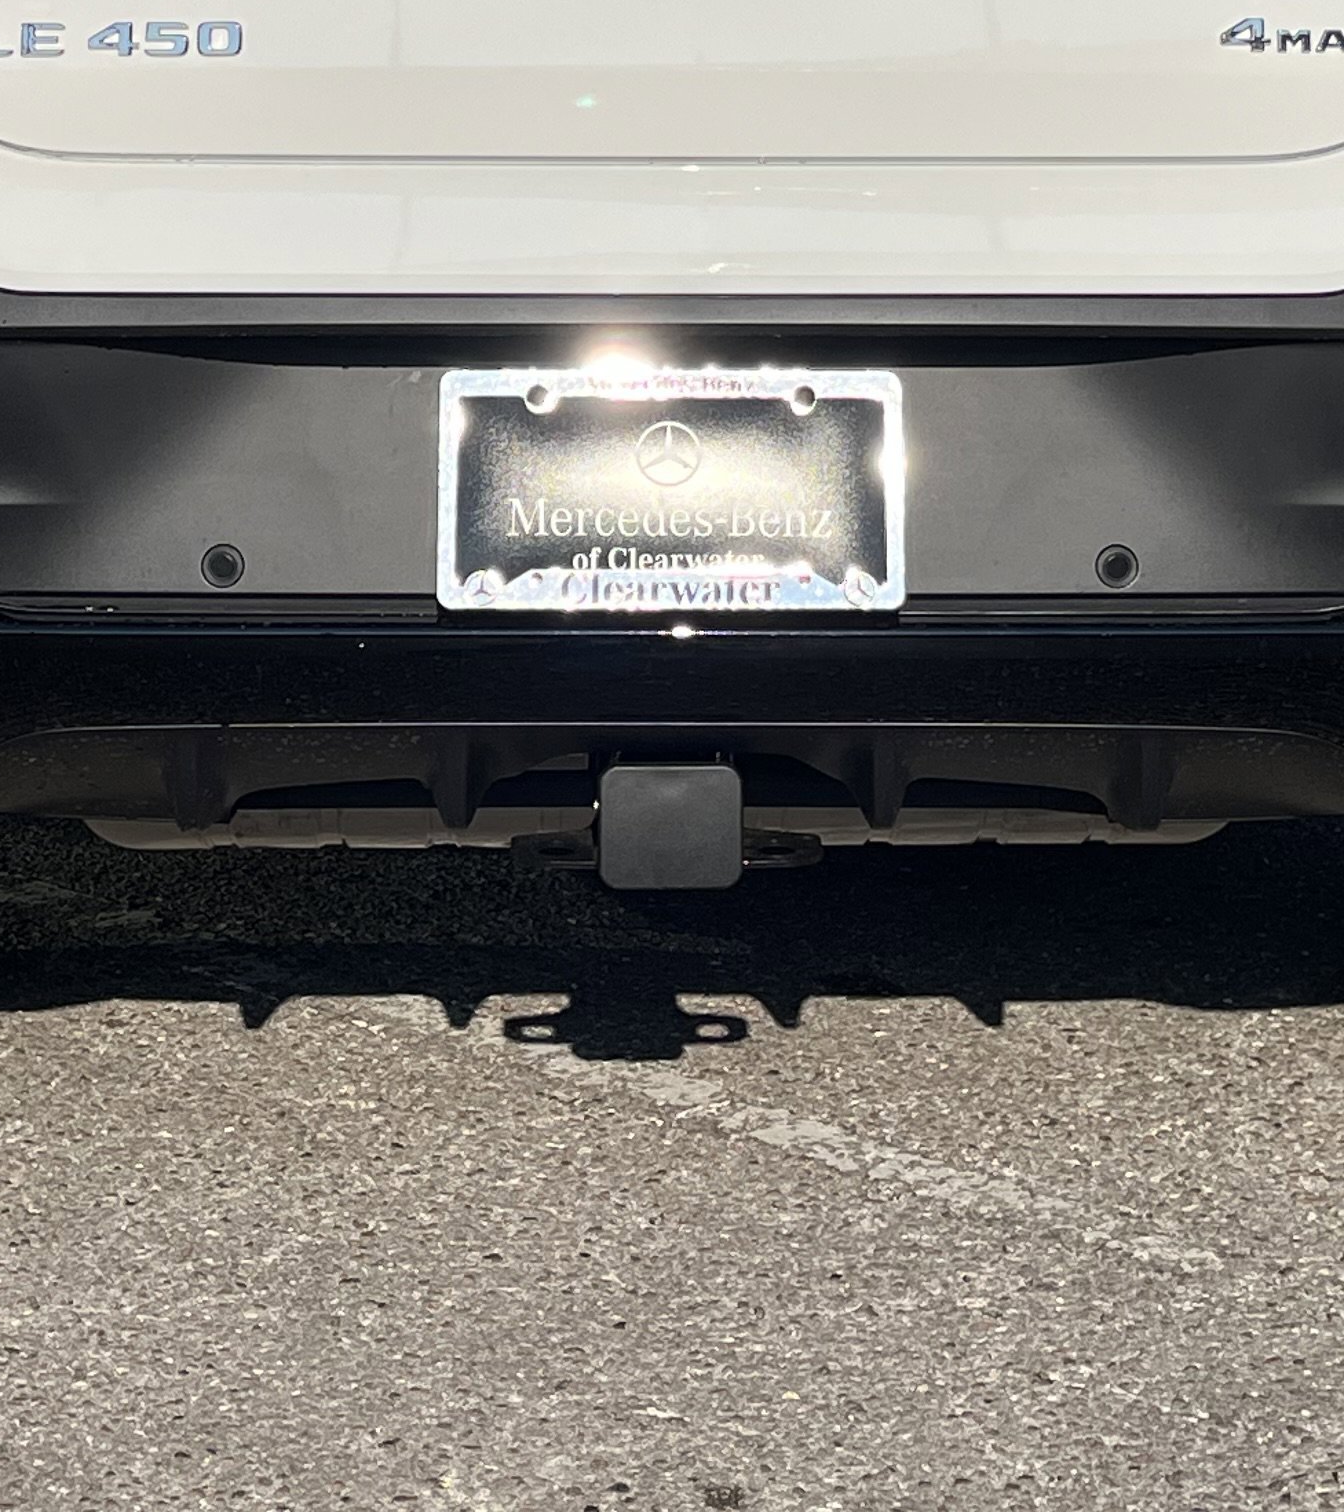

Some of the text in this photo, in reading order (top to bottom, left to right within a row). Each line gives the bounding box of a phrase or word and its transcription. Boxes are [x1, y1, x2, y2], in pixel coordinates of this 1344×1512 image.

[87, 21, 244, 57] 450
[504, 497, 833, 539] Mercedes-Benz
[572, 547, 602, 570] of
[561, 572, 781, 605] Clearwater
